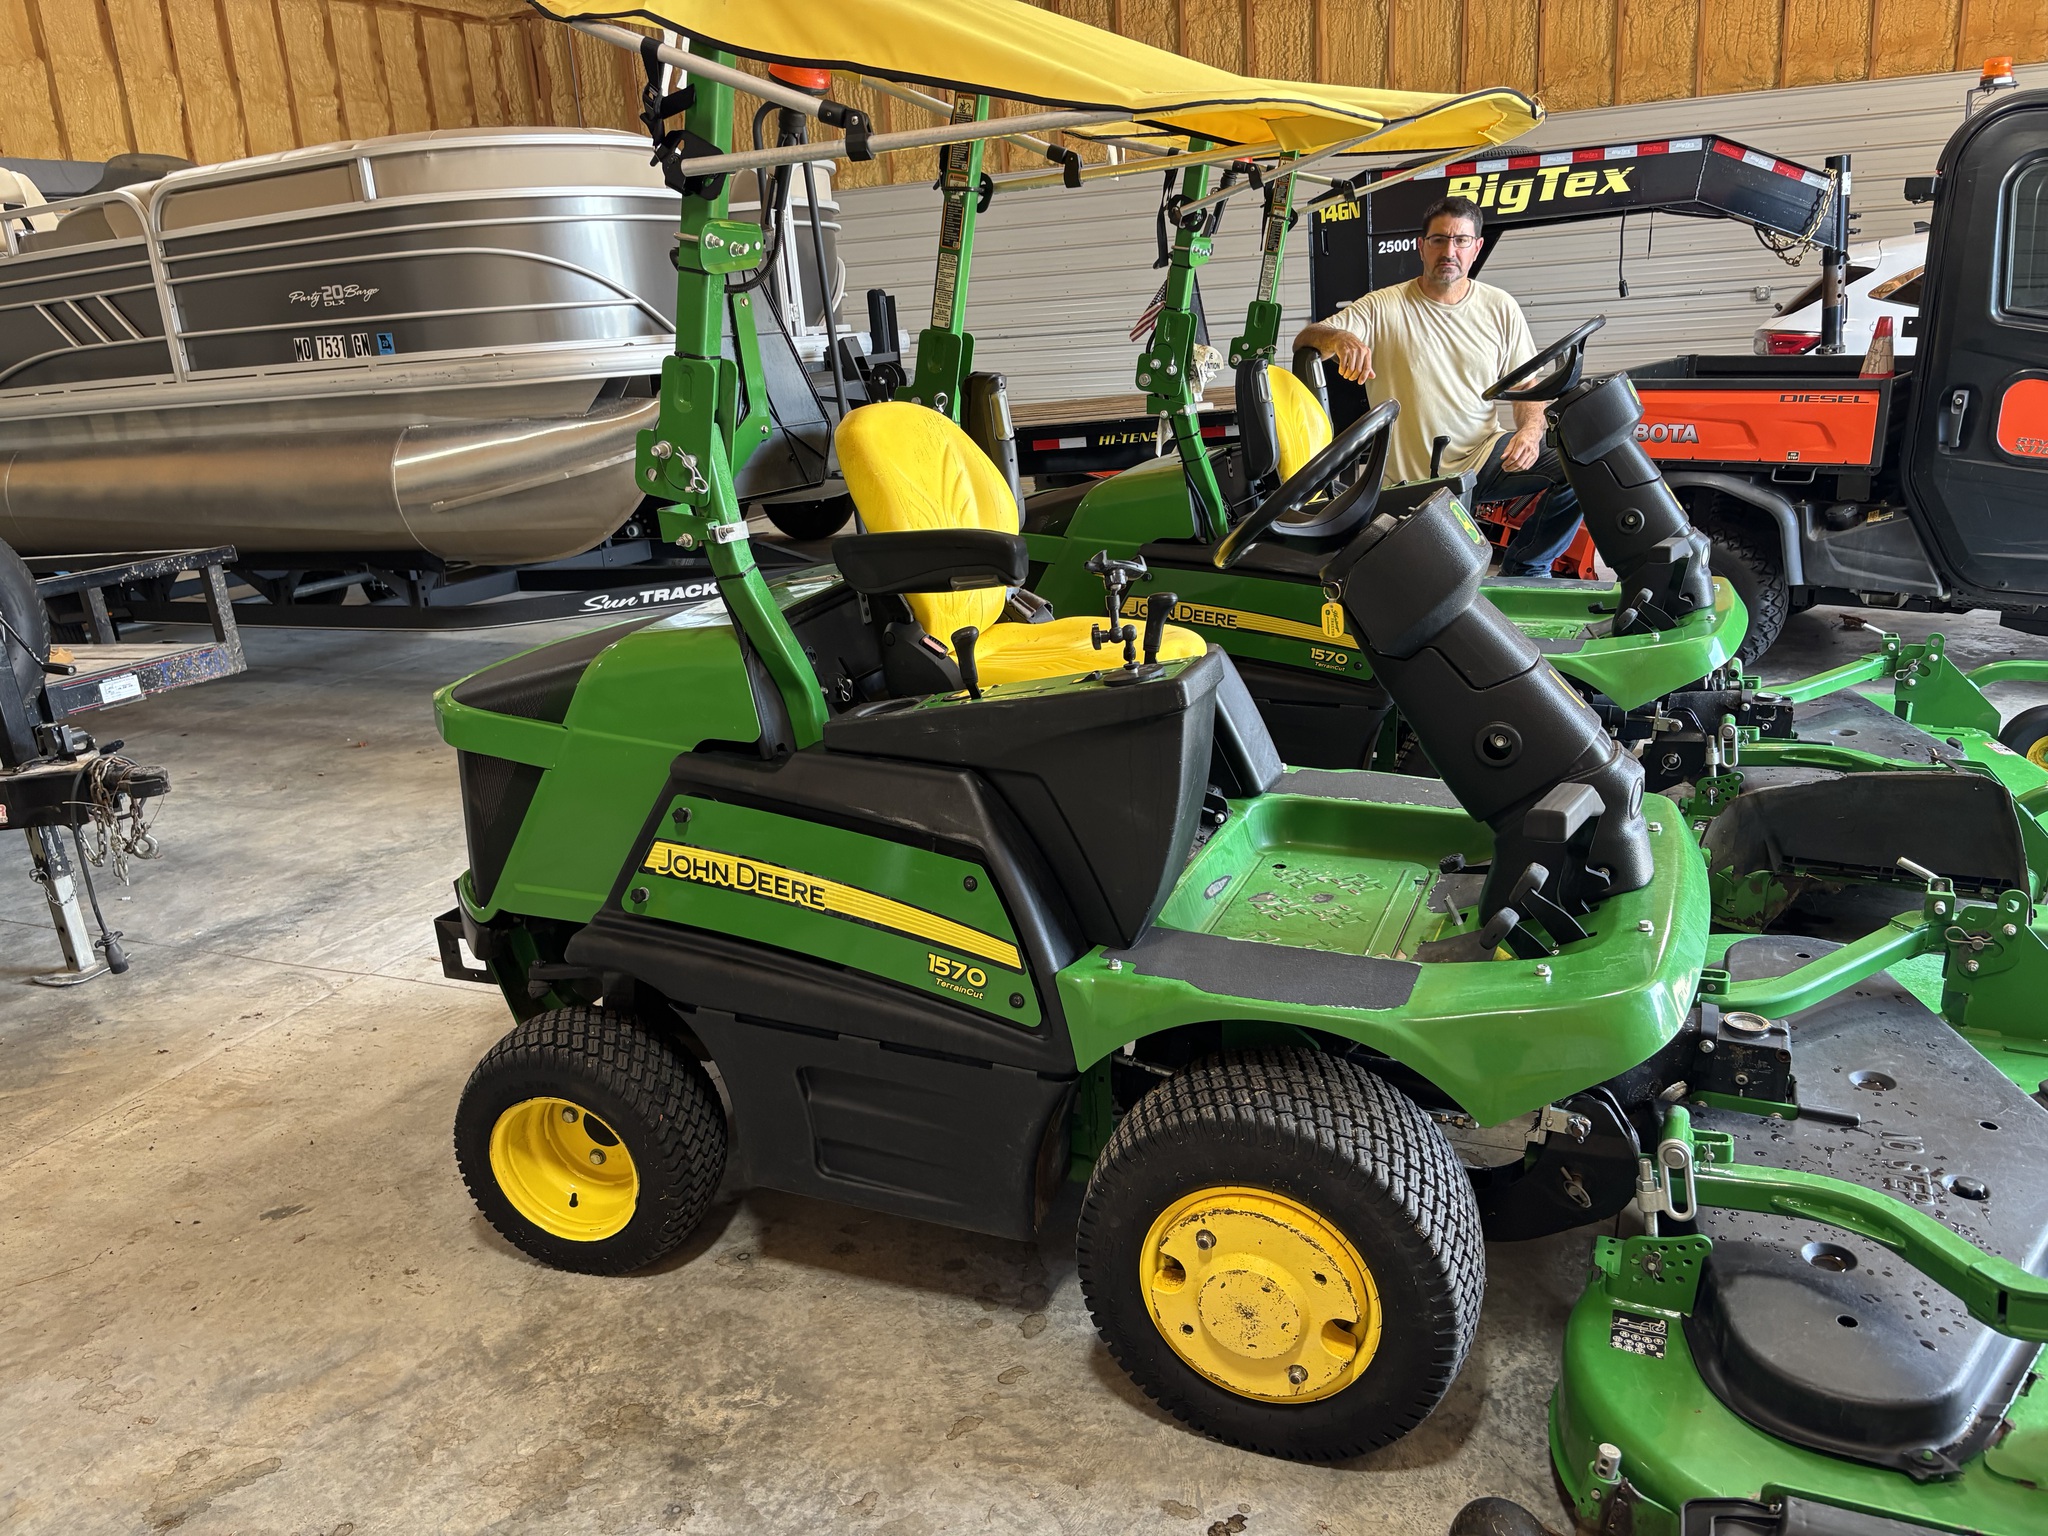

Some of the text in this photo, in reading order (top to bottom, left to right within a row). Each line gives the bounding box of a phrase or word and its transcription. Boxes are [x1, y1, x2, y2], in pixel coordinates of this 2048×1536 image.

[1446, 166, 1635, 215] BigTex
[1318, 201, 1361, 224] 14GN
[288, 284, 380, 308] Party 20 Barge
[324, 299, 346, 307] DLX
[294, 334, 371, 361] MO 7531 GN
[1780, 394, 1870, 404] DIESEL
[1099, 431, 1159, 446] HI-TENS
[1633, 423, 1699, 444] BOTA
[578, 581, 720, 612] Sun TRACK
[1129, 601, 1238, 627] JON DEERE
[1311, 647, 1348, 665] 1570
[1314, 661, 1346, 672] TerrainCut
[658, 848, 826, 908] JOHN DEERE
[928, 953, 987, 987] 1570
[935, 977, 984, 1000] TerrainCut
